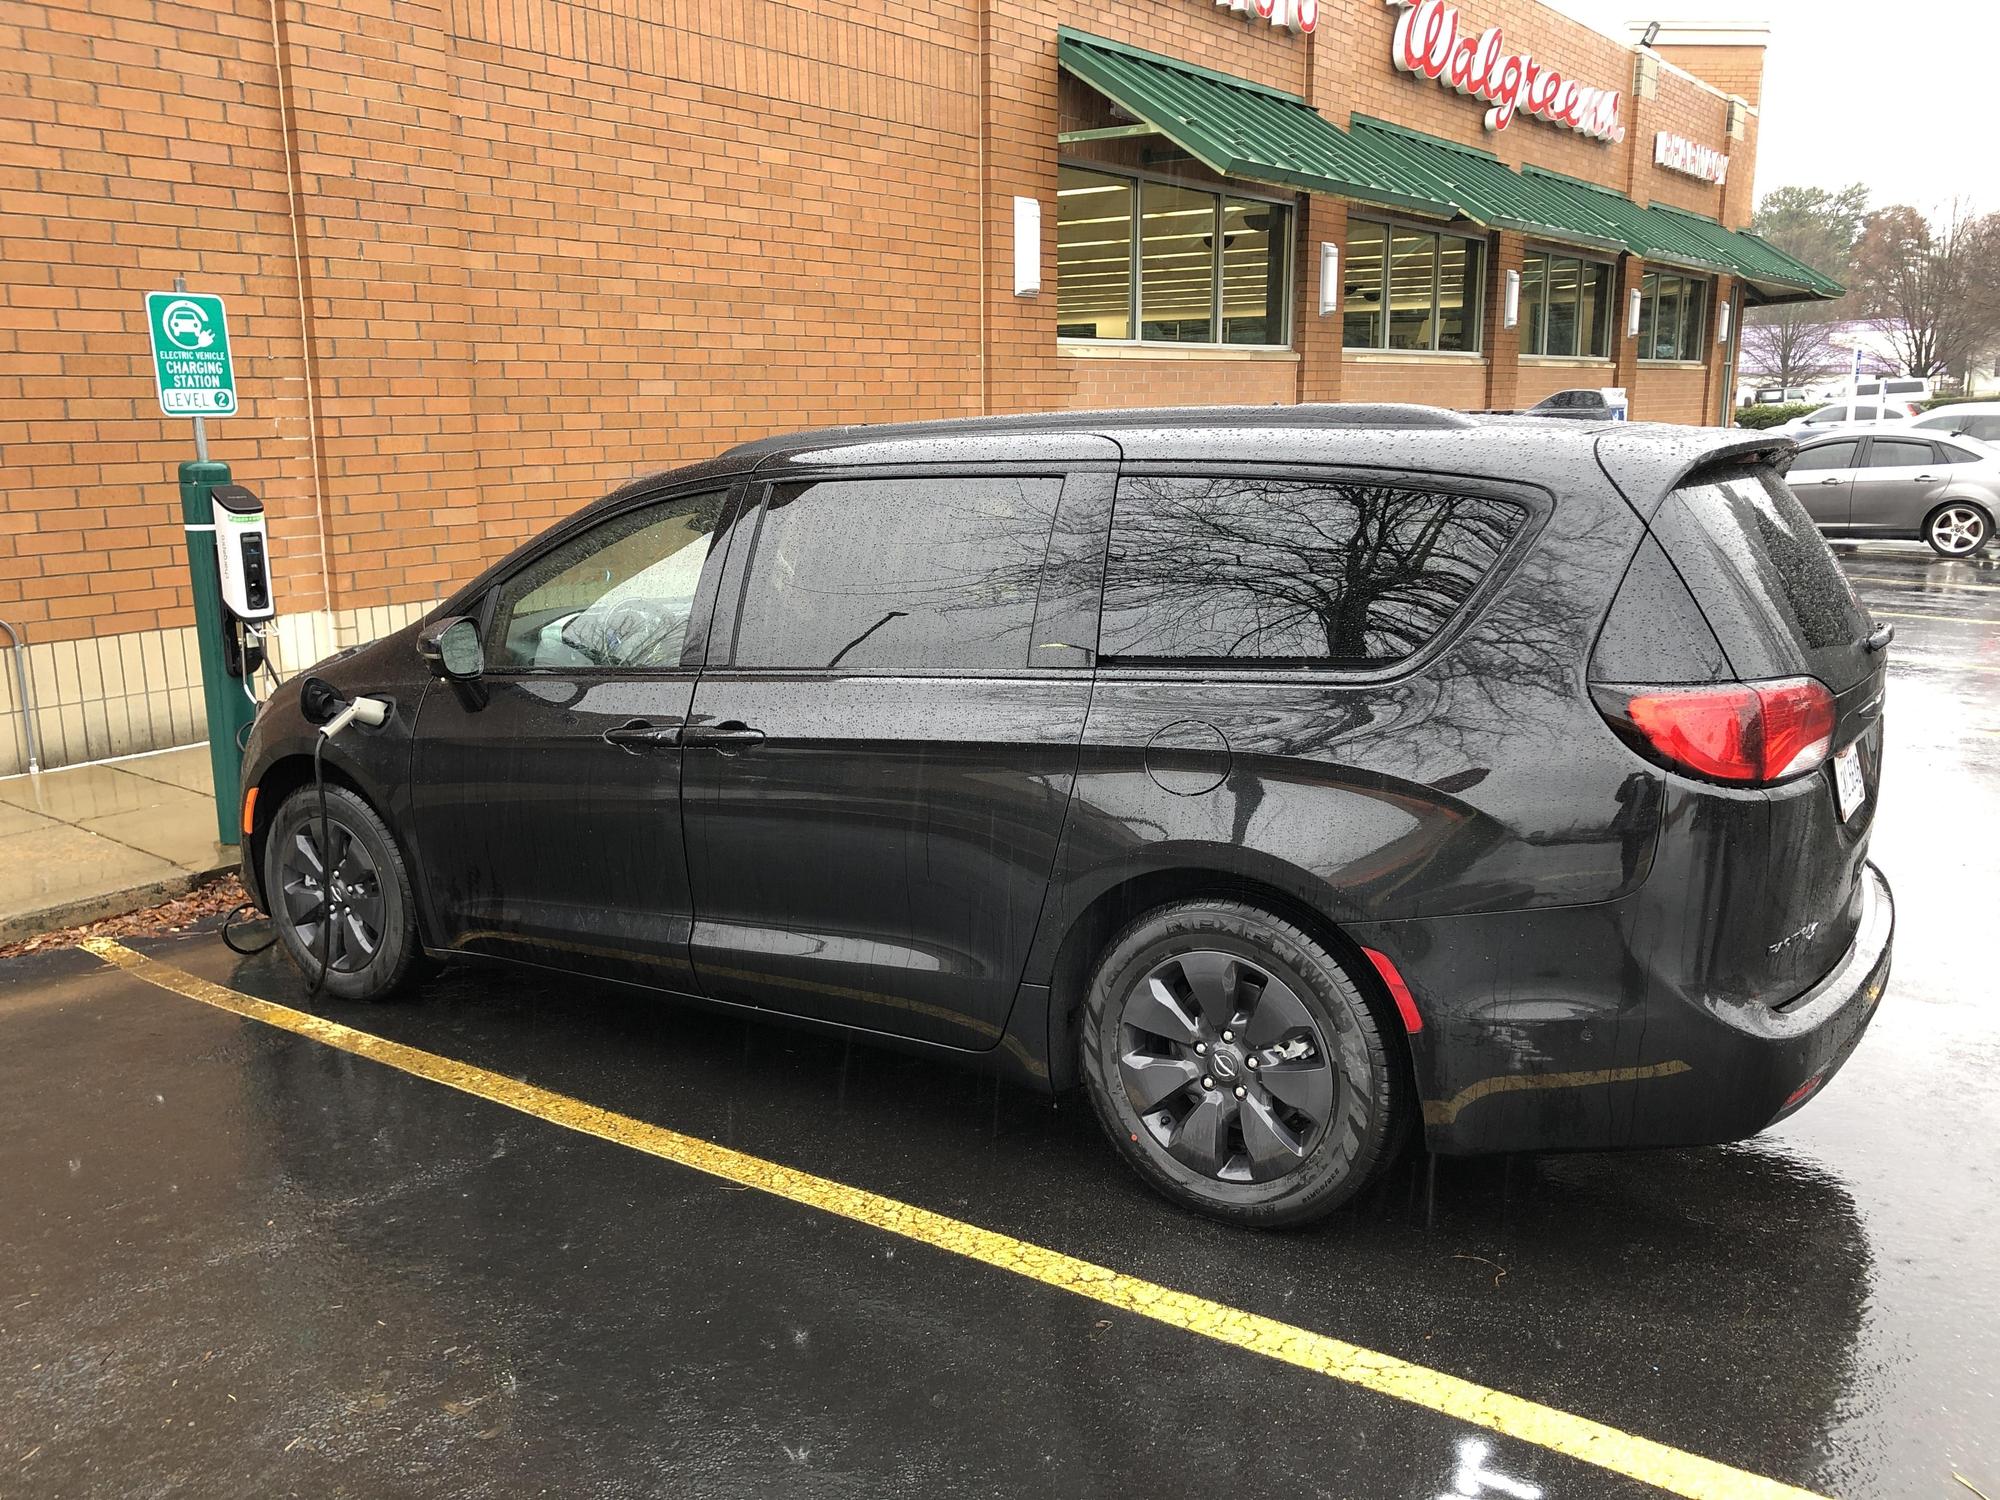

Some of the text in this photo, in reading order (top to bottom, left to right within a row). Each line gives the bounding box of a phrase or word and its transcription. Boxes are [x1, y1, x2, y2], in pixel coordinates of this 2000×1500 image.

[1391, 0, 1625, 143] Walgreens
[160, 351, 225, 360] ELECTRIC VEHICLE
[166, 361, 223, 375] CHARGING
[174, 375, 220, 388] STATION
[167, 393, 226, 407] LEVEL 2
